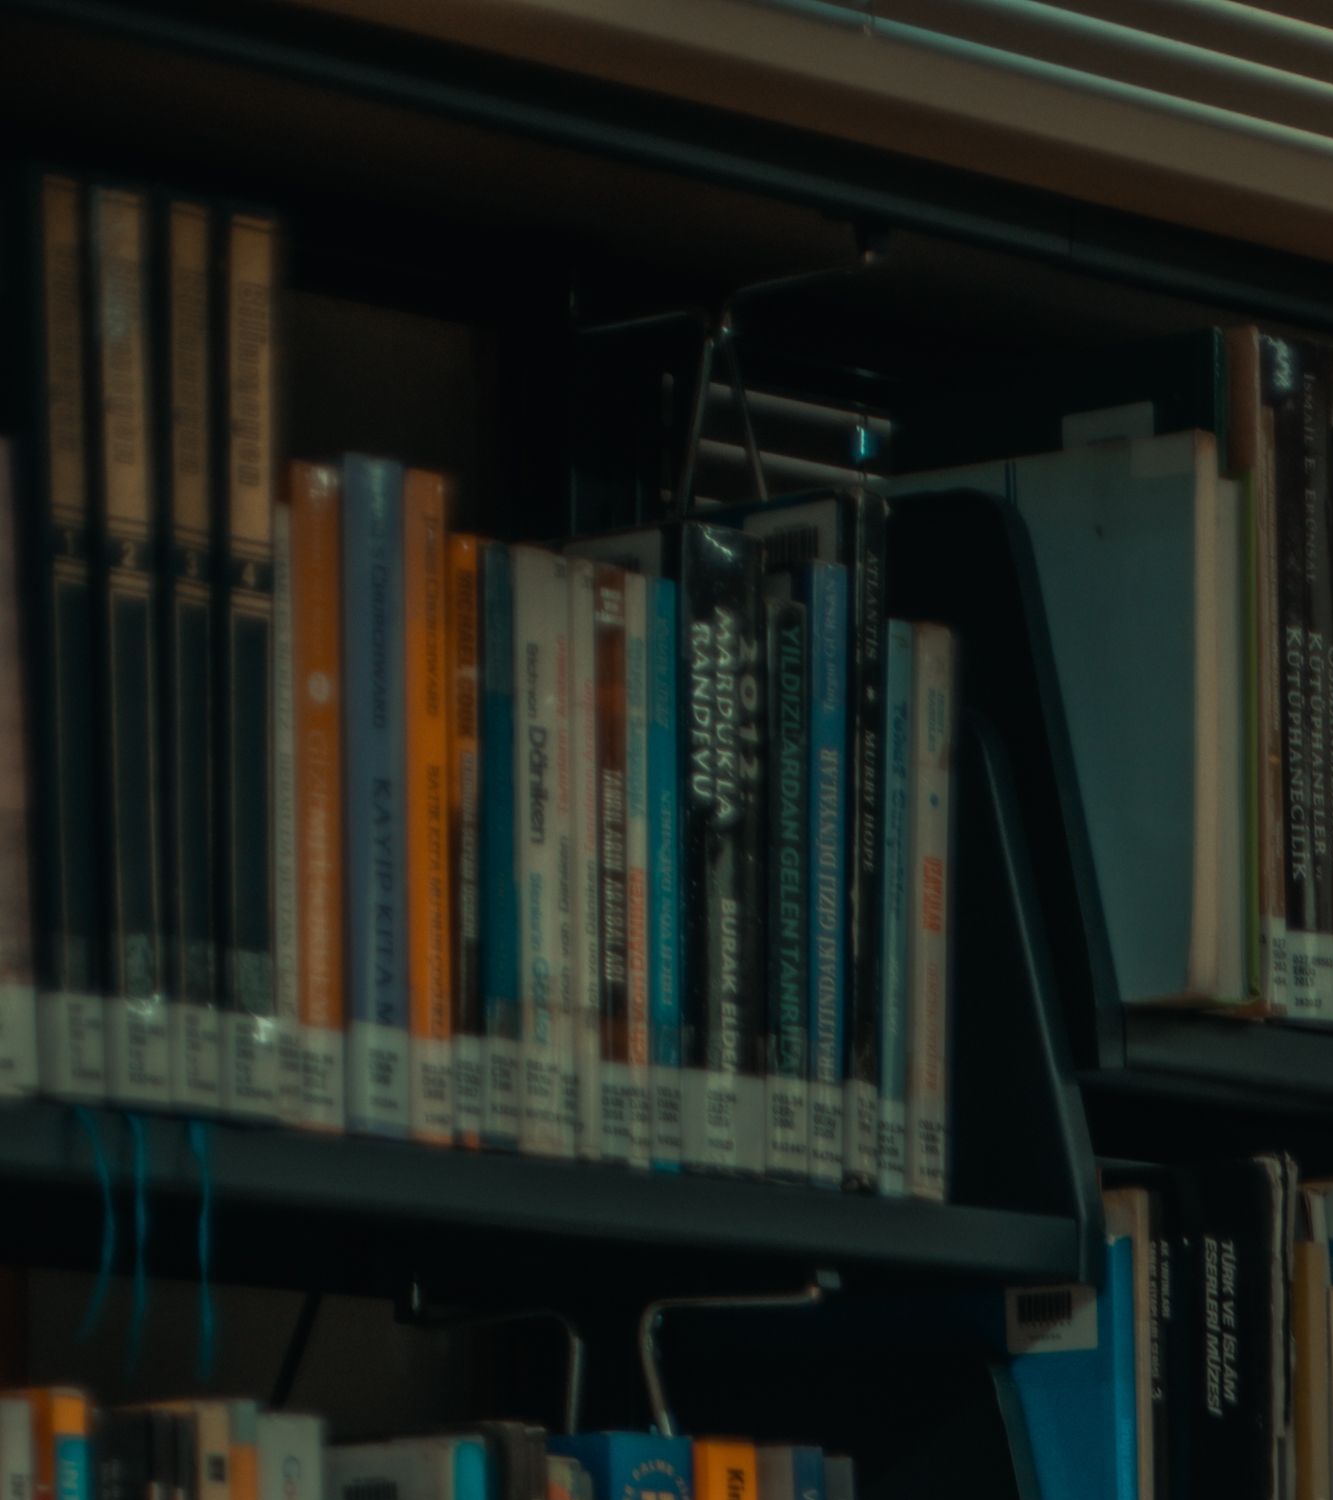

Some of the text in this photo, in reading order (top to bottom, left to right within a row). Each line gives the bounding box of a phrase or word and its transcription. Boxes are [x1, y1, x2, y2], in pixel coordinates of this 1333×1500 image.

[1285, 625, 1310, 880] KÜTÜPHANECİLİK
[1309, 631, 1329, 854] KÜTÜPHANELER
[779, 847, 802, 938] GELEN
[1203, 1238, 1224, 1416] ESERLERİ MÜZESİ
[1219, 1241, 1236, 1295] TÜRK
[1220, 1301, 1236, 1328] VE
